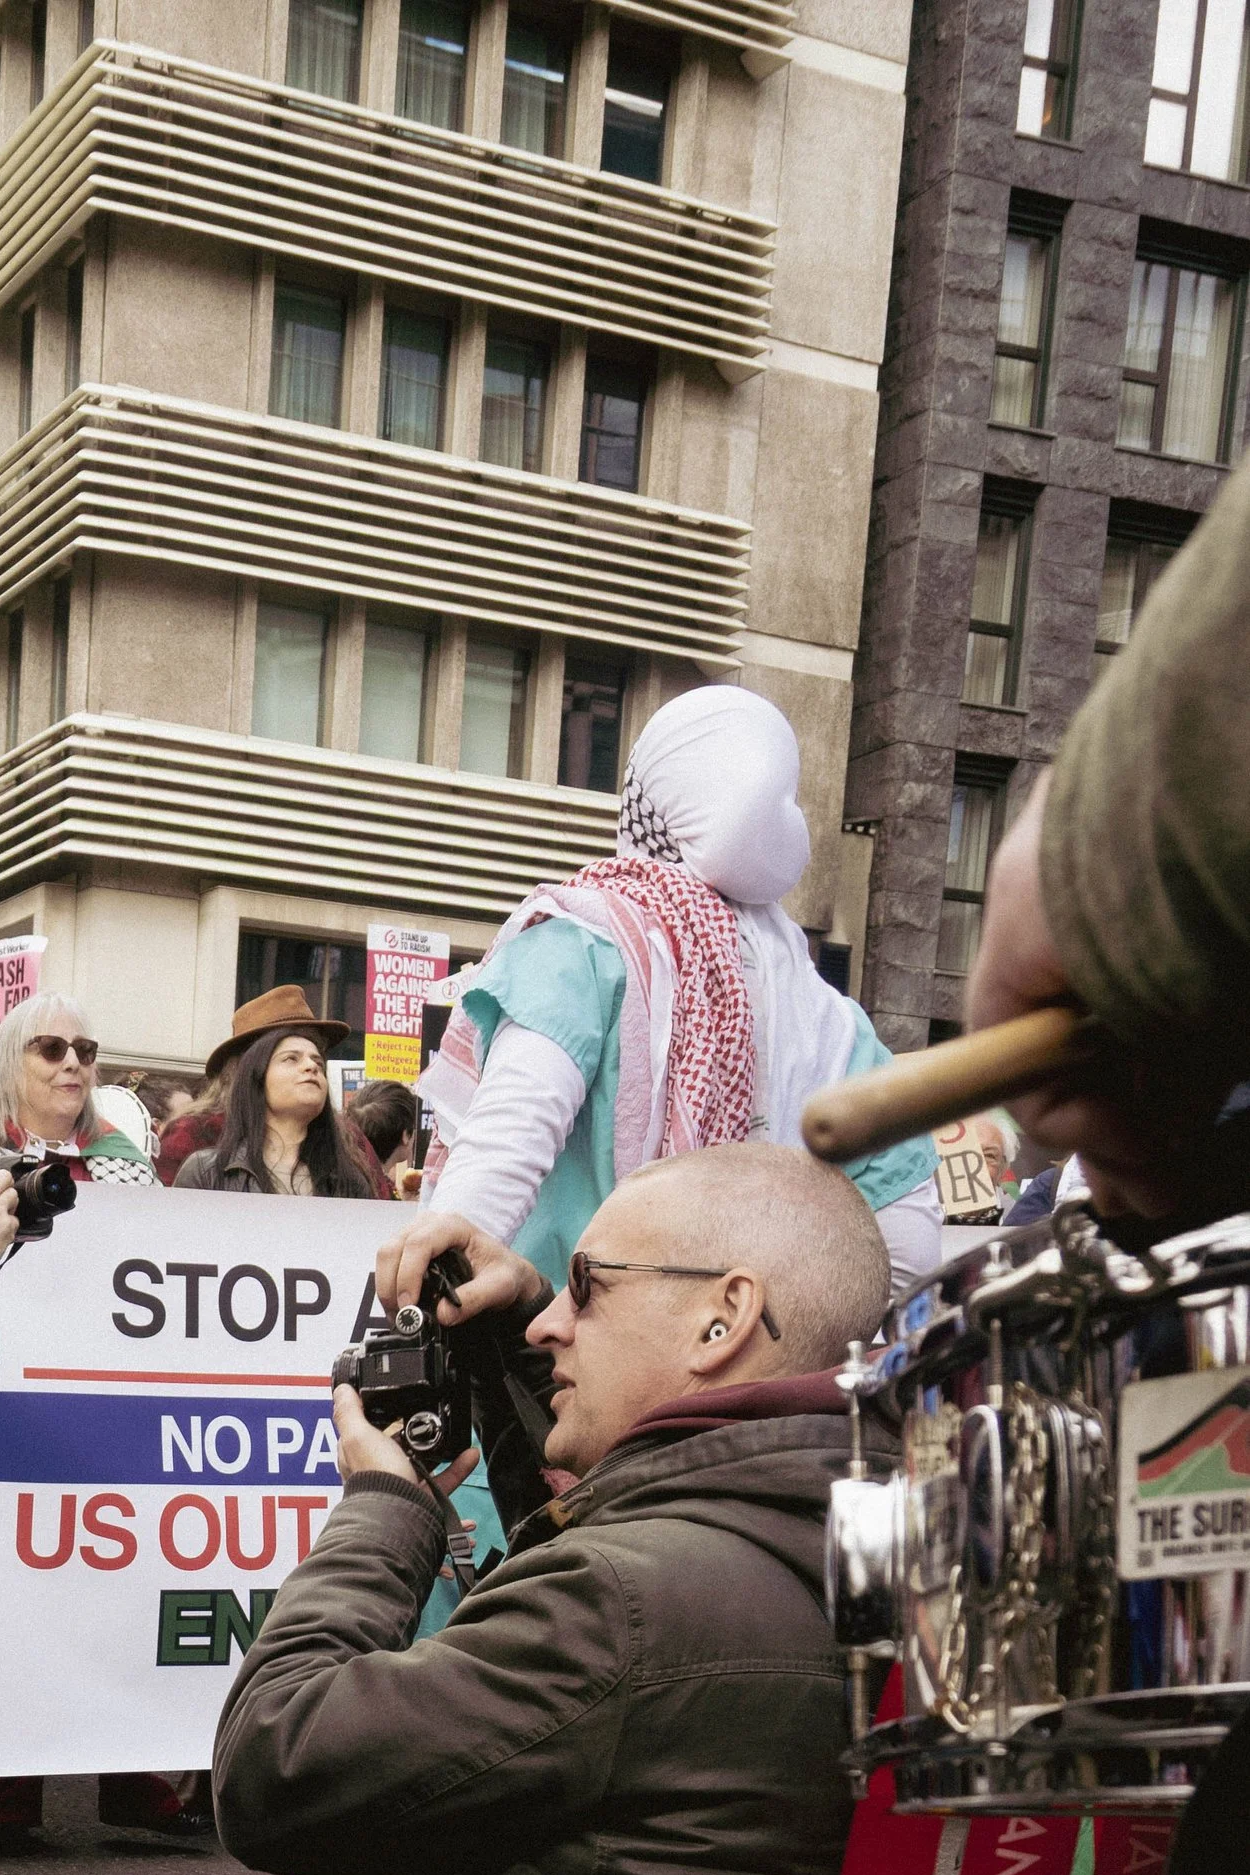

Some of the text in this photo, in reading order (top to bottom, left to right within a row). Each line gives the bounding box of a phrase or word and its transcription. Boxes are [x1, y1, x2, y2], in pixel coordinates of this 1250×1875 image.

[7, 944, 29, 955] Worker
[401, 932, 428, 943] STAND UP
[401, 942, 431, 953] TO RACISM
[374, 954, 435, 979] WOMEN
[373, 993, 406, 1014] THE
[373, 1012, 421, 1036] RIGHT
[376, 1041, 401, 1051] Reject
[376, 1053, 413, 1065] Refugees
[112, 1258, 331, 1342] STOP
[161, 1415, 252, 1475] NO
[16, 1492, 329, 1571] US OUT
[1137, 1505, 1183, 1543] THE
[156, 1589, 281, 1667] EN
